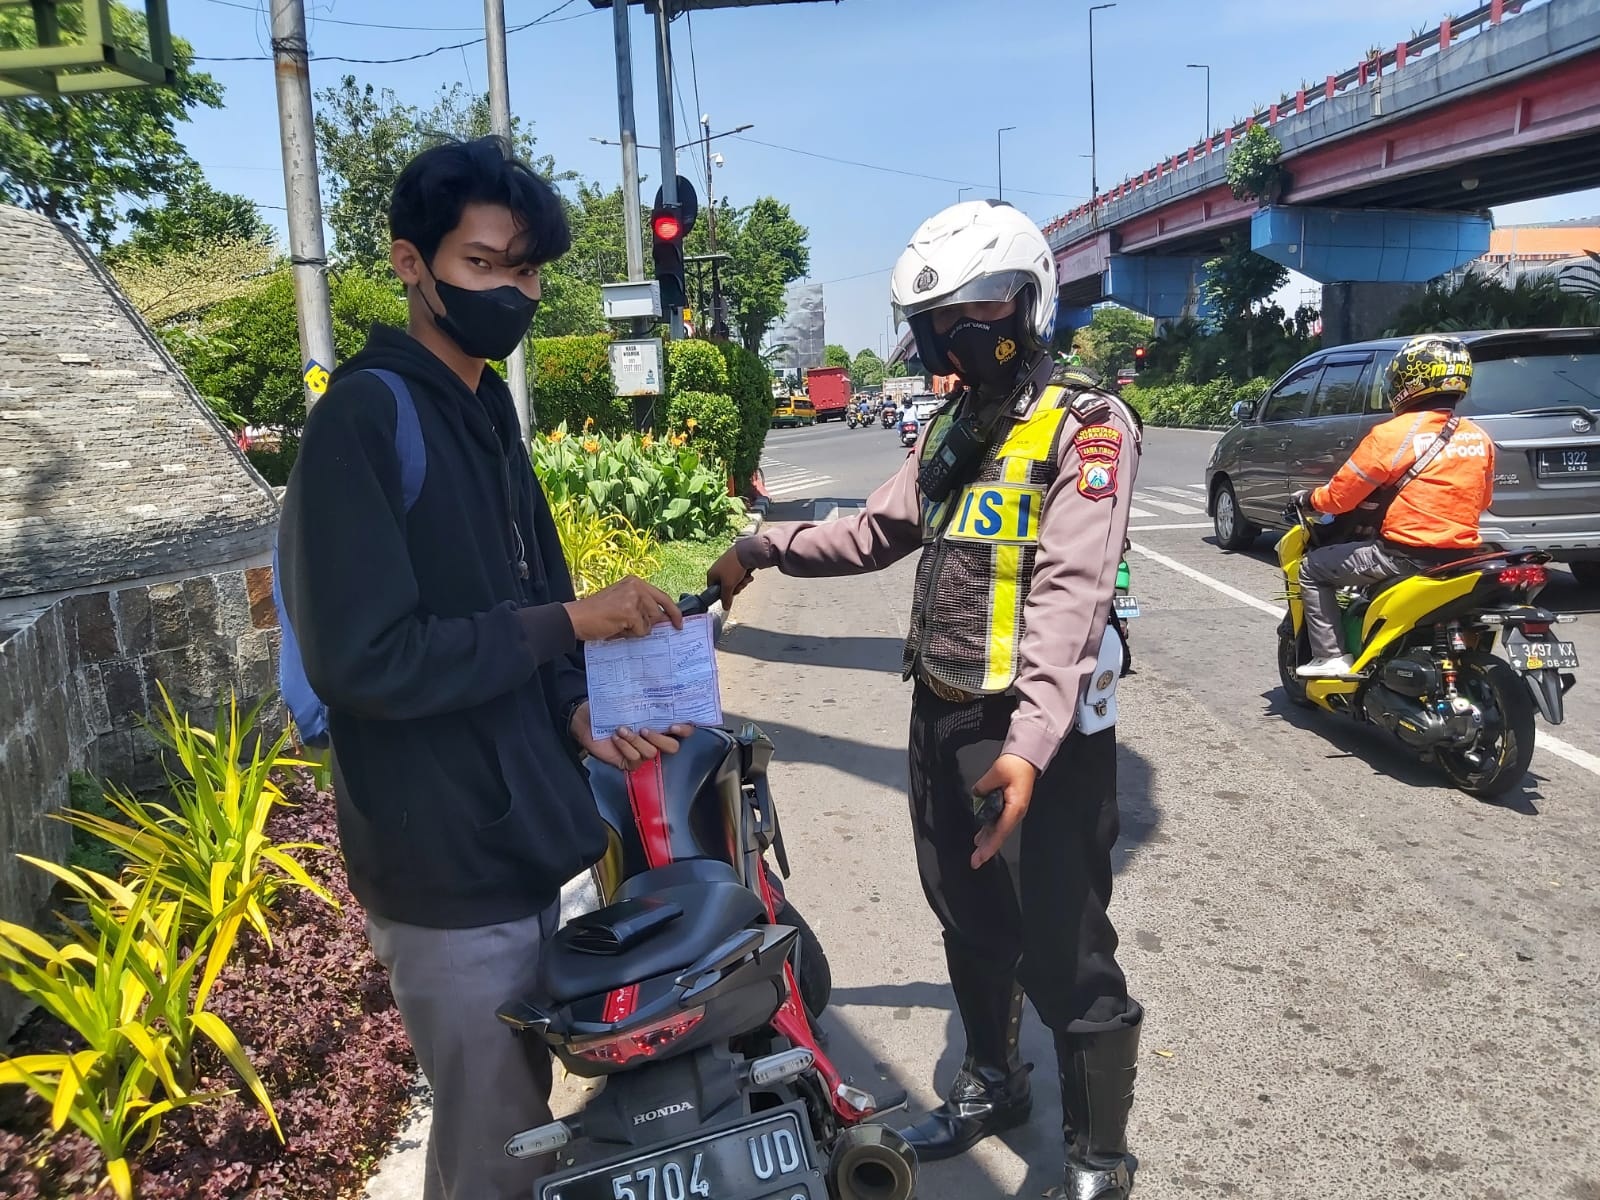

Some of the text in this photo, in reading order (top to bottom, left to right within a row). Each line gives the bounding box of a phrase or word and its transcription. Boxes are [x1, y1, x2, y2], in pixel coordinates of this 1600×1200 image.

[1445, 441, 1486, 459] Food
[1542, 451, 1588, 466] L 1322
[1508, 643, 1575, 657] L 3497 KX
[633, 1101, 695, 1125] HONDA
[612, 1129, 800, 1200] 5704 UD
